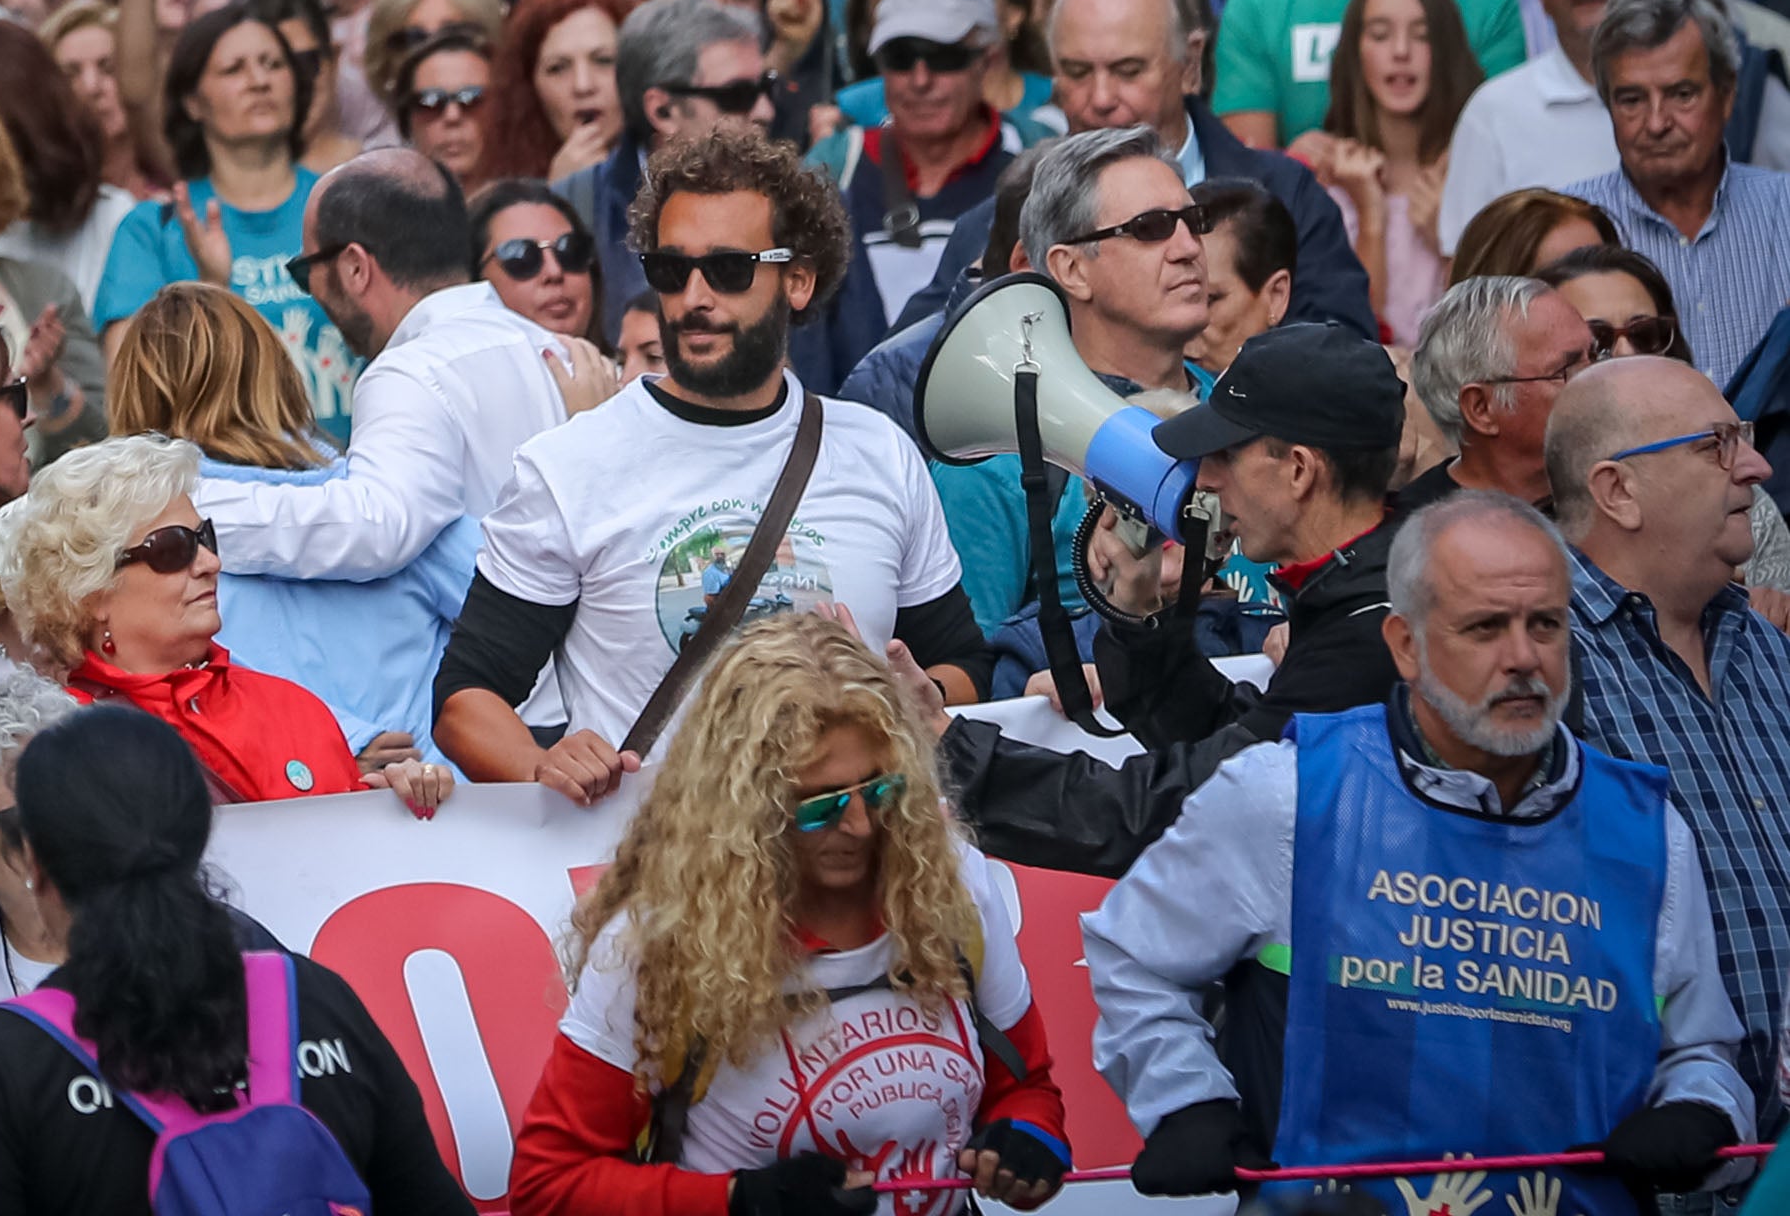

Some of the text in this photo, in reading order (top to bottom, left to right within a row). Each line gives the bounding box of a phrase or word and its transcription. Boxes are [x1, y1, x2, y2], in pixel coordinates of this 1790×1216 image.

[711, 497, 746, 513] con
[1367, 868, 1603, 931] ASOCIACION
[1398, 914, 1572, 965] JUSTICIA
[1340, 954, 1619, 1012] por la SANIDAD
[815, 1065, 874, 1122] POR
[873, 1050, 938, 1077] UNA
